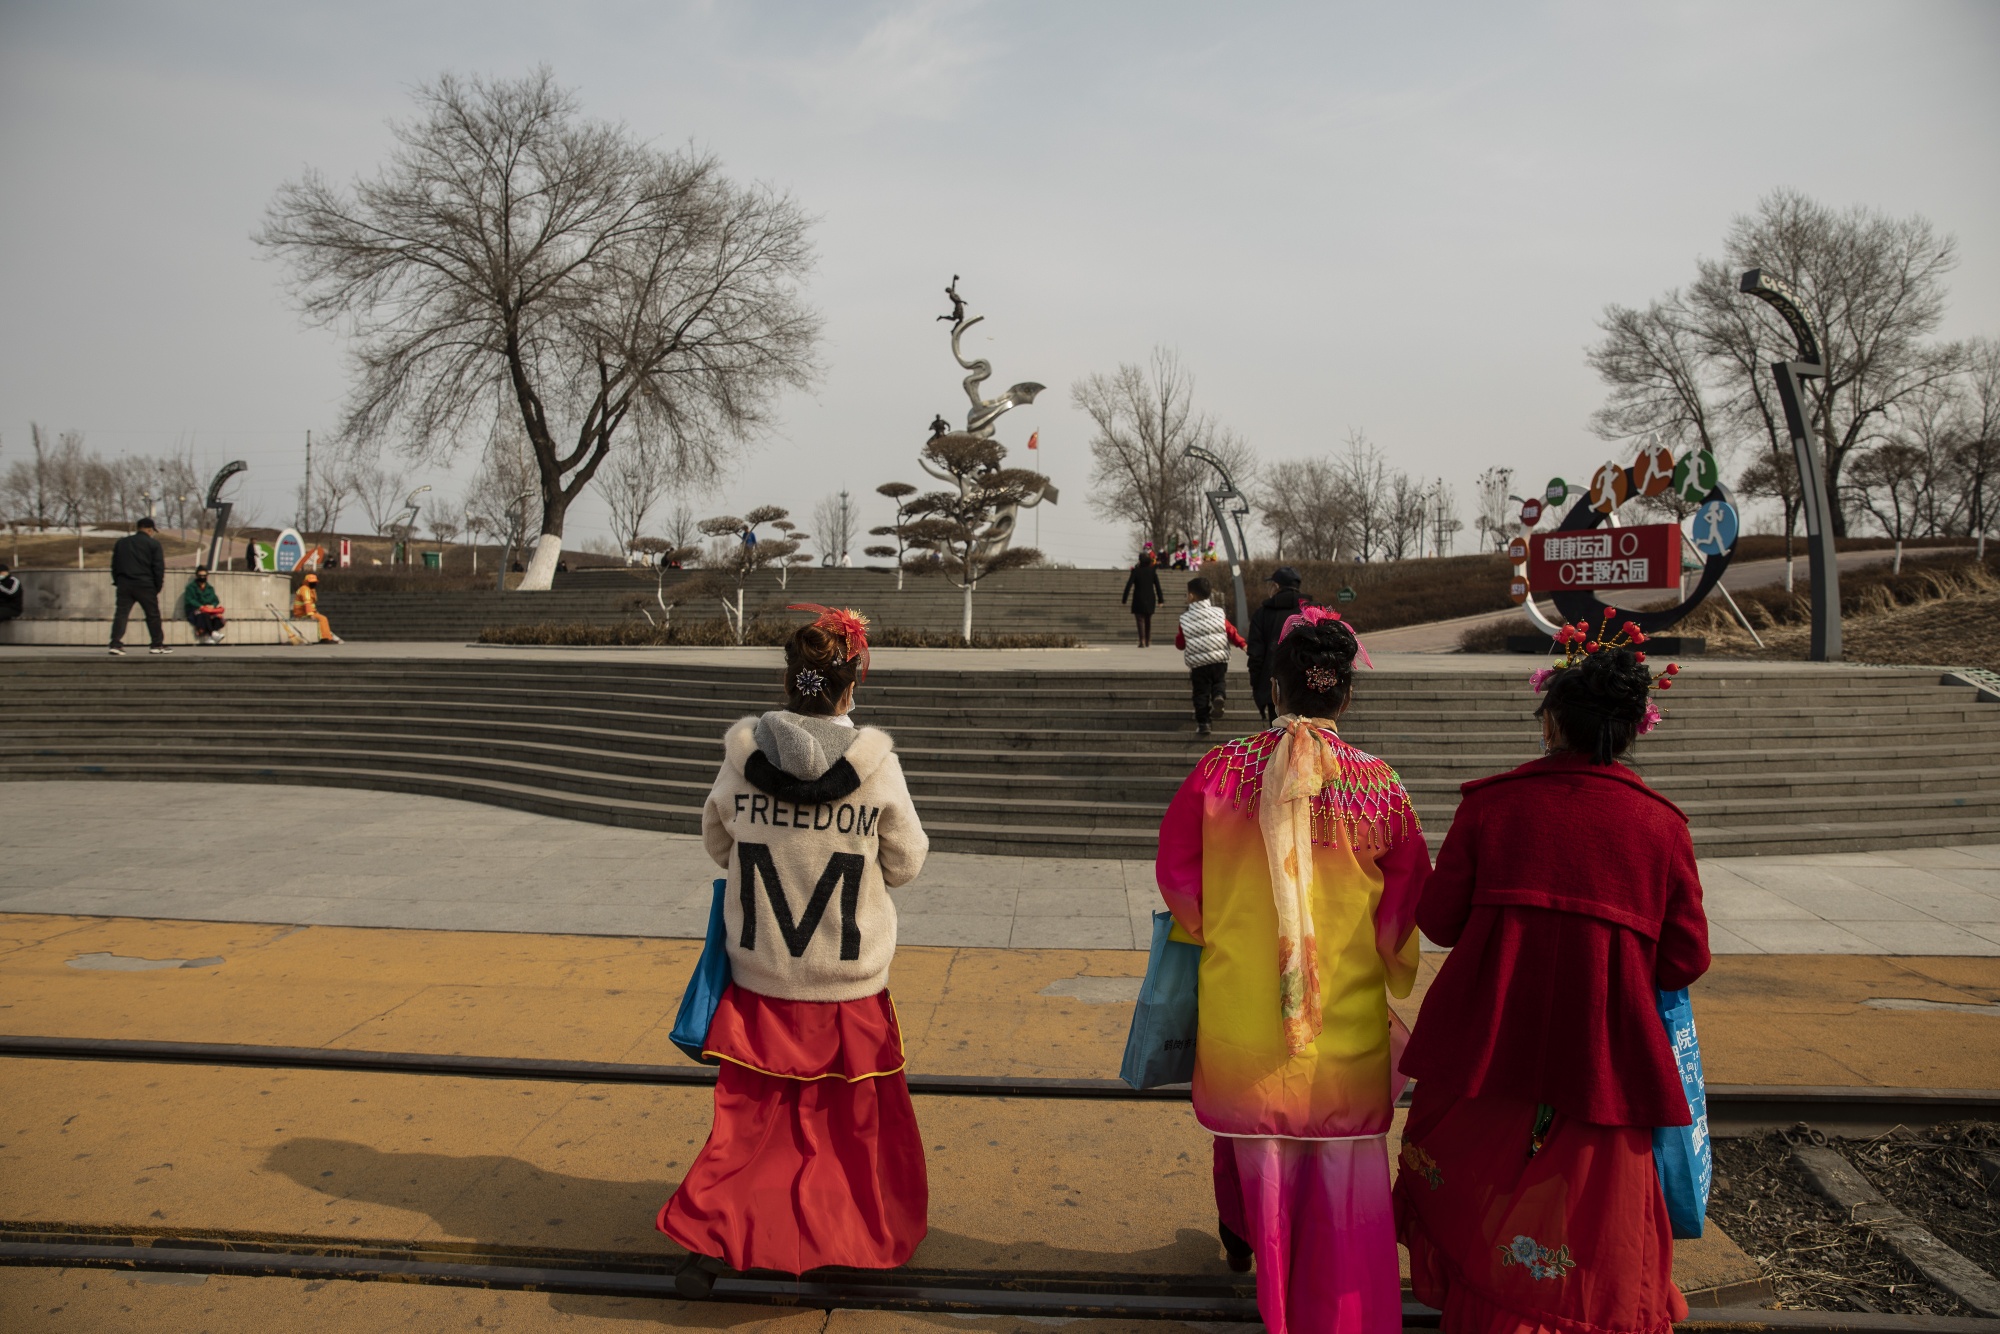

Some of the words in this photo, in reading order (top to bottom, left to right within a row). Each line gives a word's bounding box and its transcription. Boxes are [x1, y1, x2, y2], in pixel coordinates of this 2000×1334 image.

[1544, 535, 1612, 561] 健康运动
[1575, 559, 1648, 585] 主题公园
[733, 794, 879, 837] FREEDOM
[737, 841, 865, 961] M
